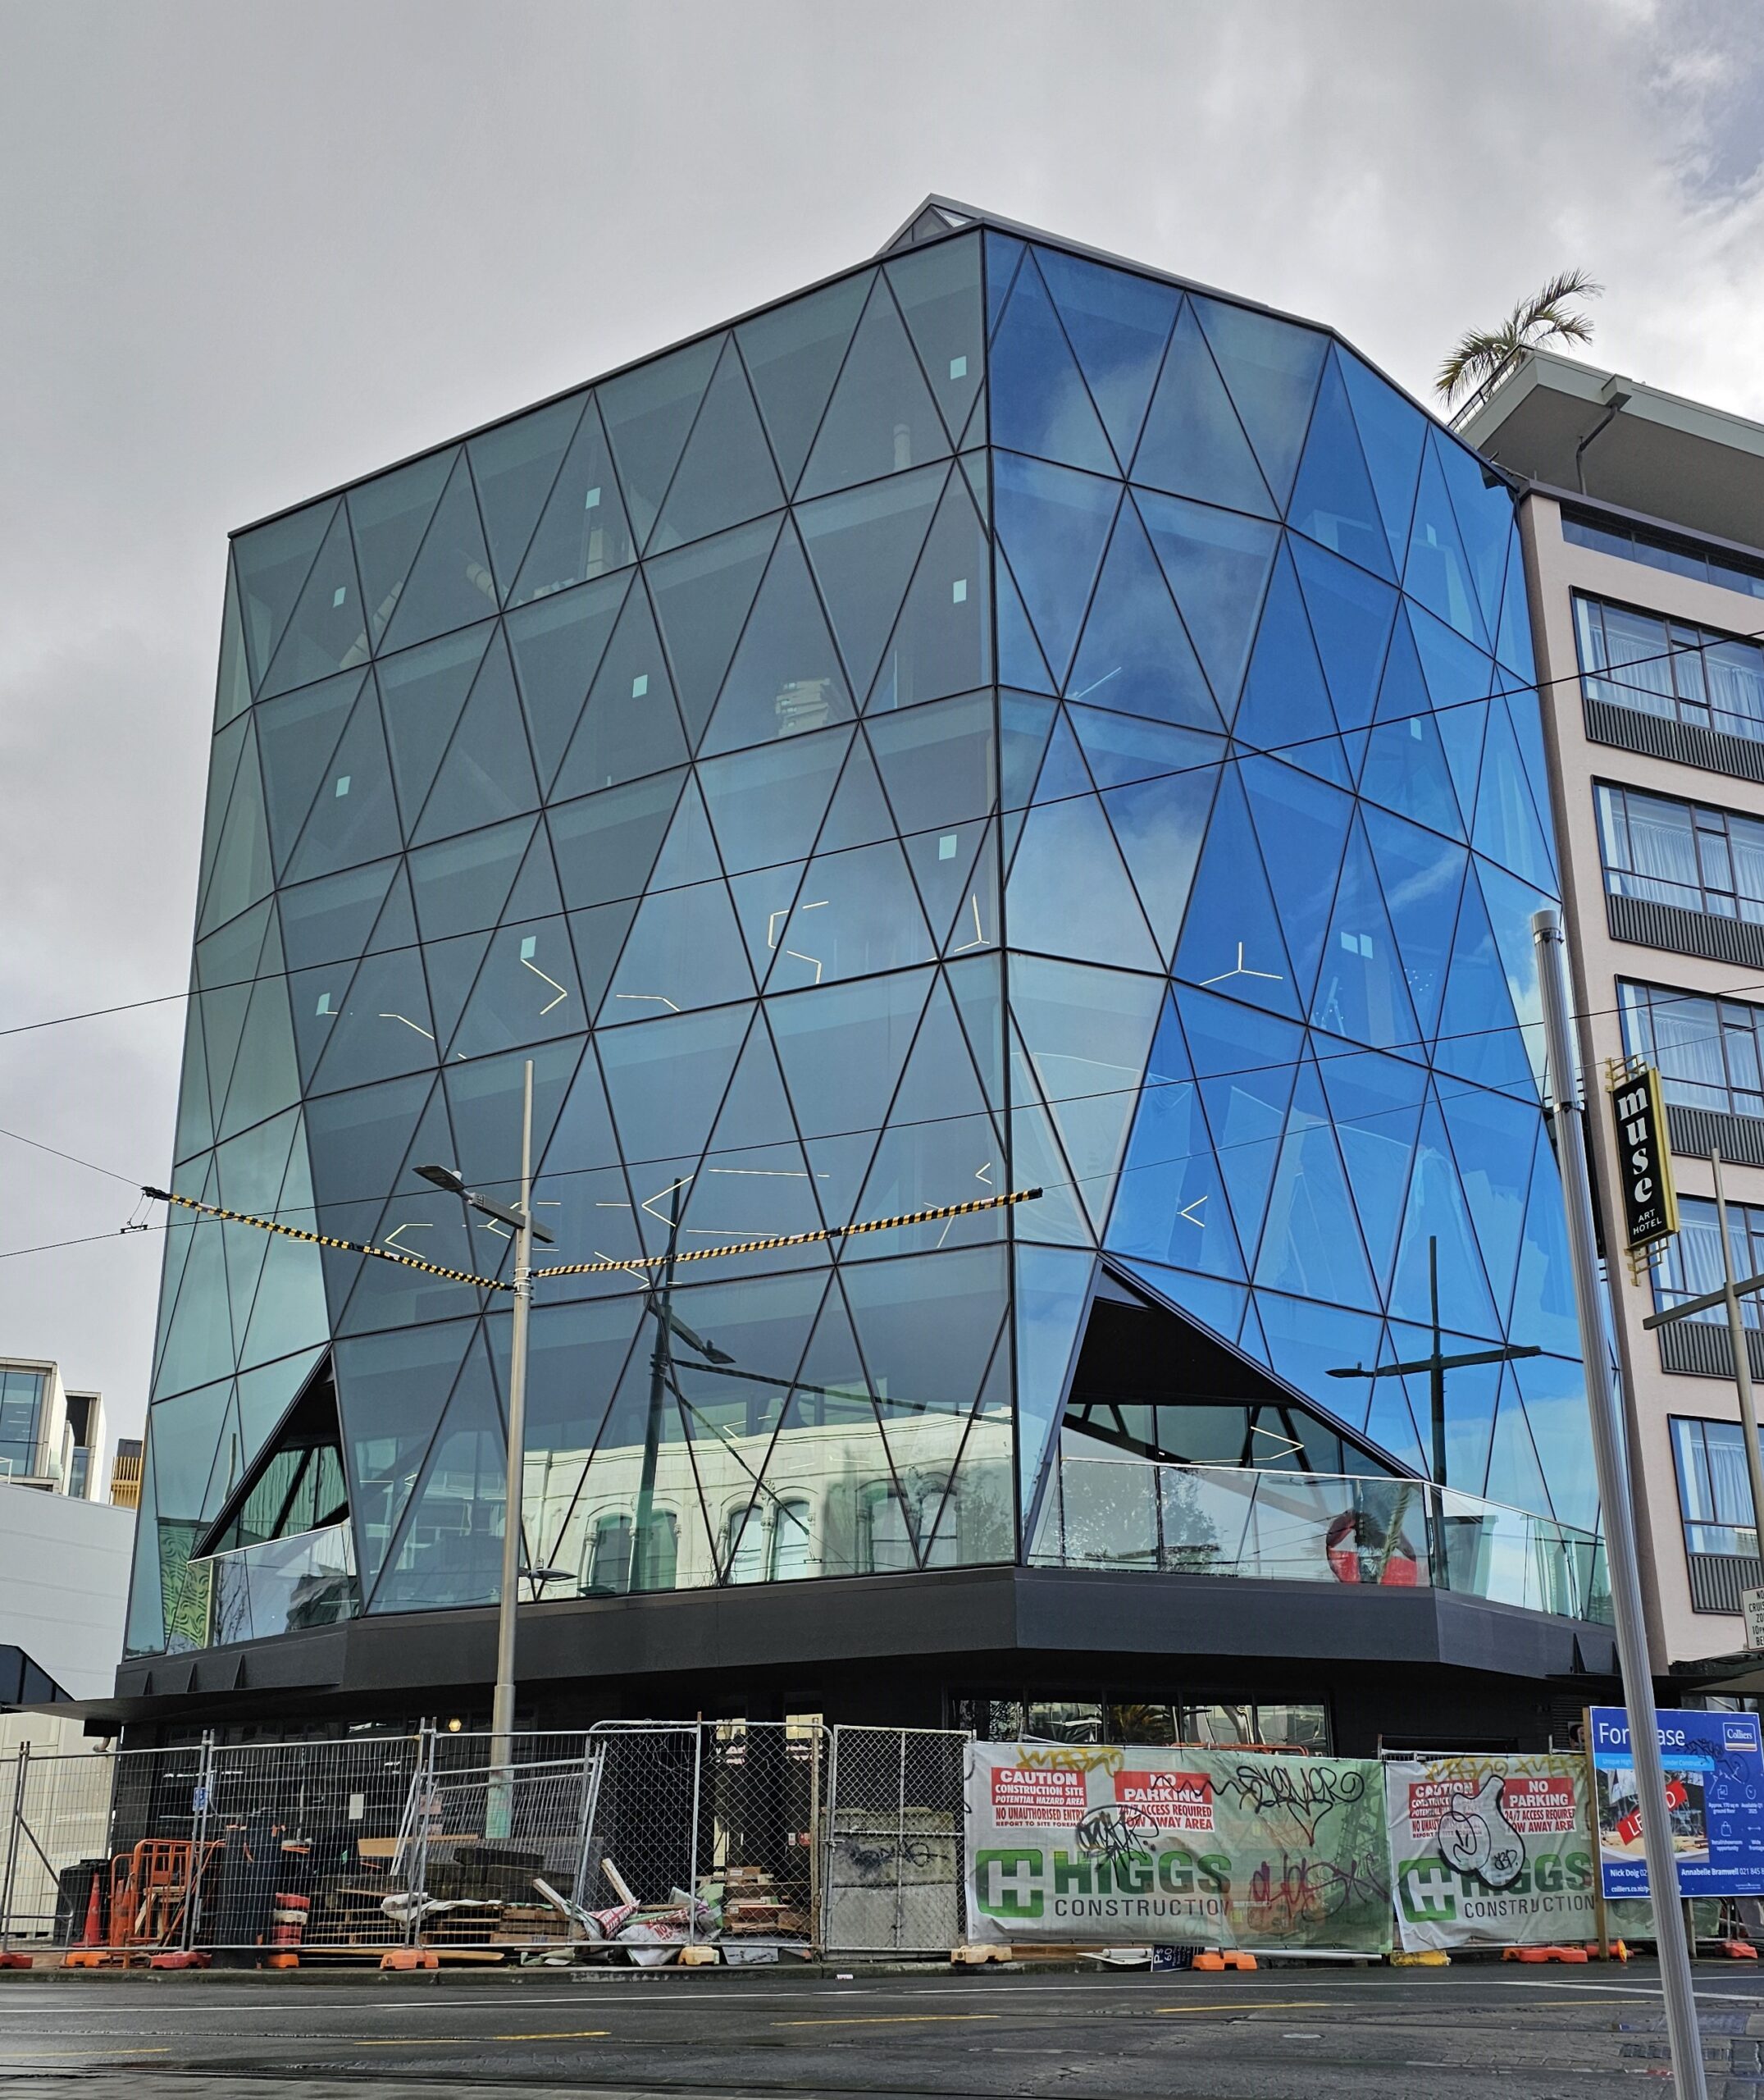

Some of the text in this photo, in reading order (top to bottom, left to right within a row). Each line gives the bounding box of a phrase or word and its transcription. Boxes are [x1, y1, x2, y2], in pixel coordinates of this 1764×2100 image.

[1618, 1088, 1653, 1203] muse
[1638, 1208, 1656, 1223] ART
[1633, 1218, 1662, 1235] HOTEL
[1599, 1723, 1630, 1744] For
[1727, 1728, 1753, 1740] Colliers
[1001, 1770, 1078, 1785] CAUTION
[1151, 1774, 1176, 1787] NO
[996, 1784, 1084, 1796] CONSTRUCTION SITE
[1415, 1783, 1474, 1797] CAUTION
[1529, 1781, 1548, 1793] NO
[996, 1796, 1034, 1804] POTENTIAL
[1037, 1796, 1064, 1805] HAZARD
[1124, 1788, 1203, 1802] PARKING
[1510, 1794, 1568, 1807] PARKING
[996, 1807, 1085, 1820] NO UNAUTHORISED ENTRY
[1142, 1805, 1170, 1815] ACCESS
[1173, 1806, 1212, 1817] REQUIRED
[1505, 1810, 1520, 1821] 24/7
[1523, 1810, 1543, 1820] ACCESS
[1185, 1818, 1213, 1830] AREA
[1529, 1821, 1552, 1833] AWAY
[1054, 1851, 1231, 1895] HIGGS
[1625, 1869, 1639, 1879] Doig
[1681, 1868, 1711, 1876] Annabelle
[1055, 1899, 1230, 1916] CONSTRUCTION
[1465, 1895, 1594, 1918] CONSTRUCTION
